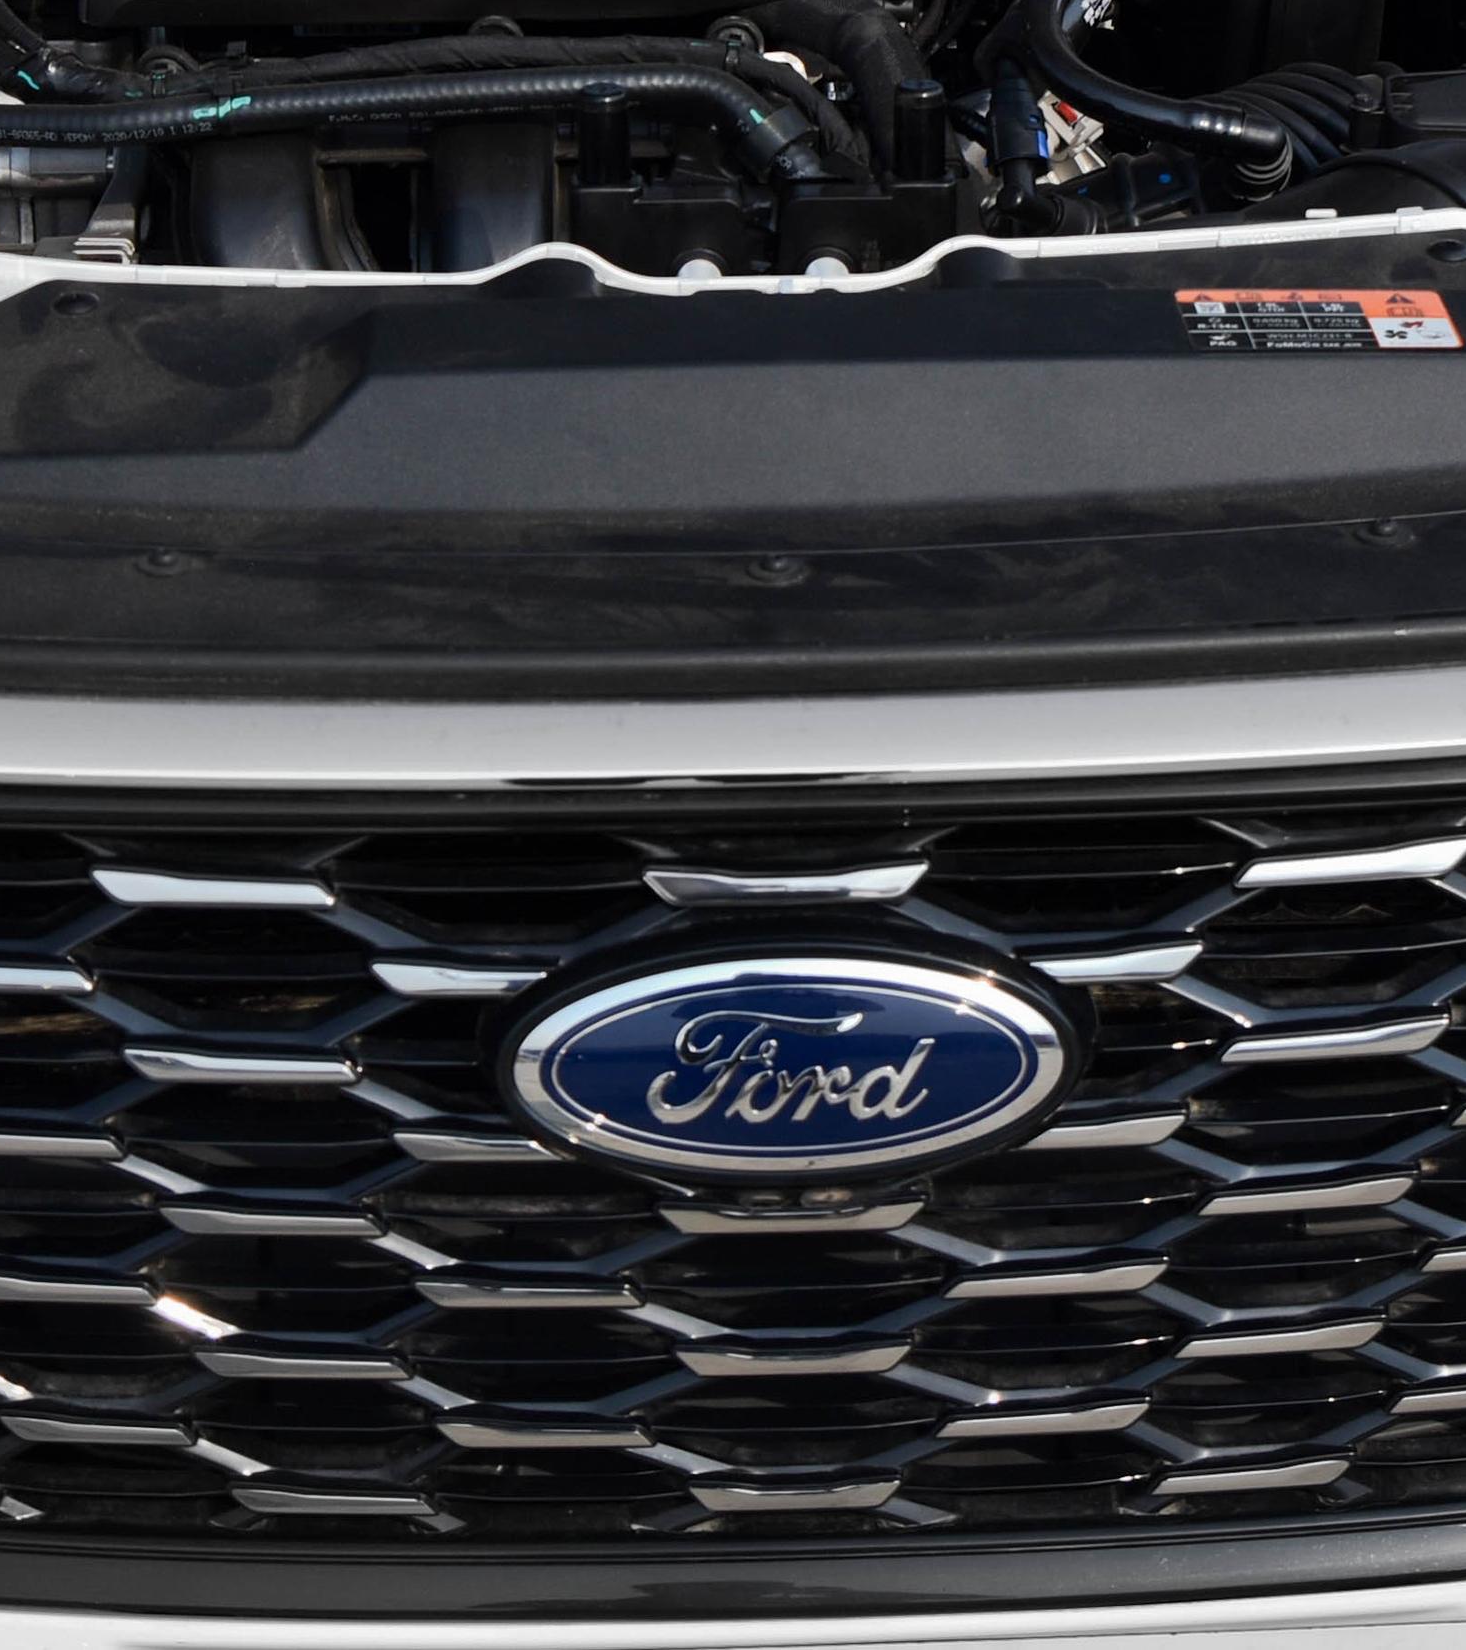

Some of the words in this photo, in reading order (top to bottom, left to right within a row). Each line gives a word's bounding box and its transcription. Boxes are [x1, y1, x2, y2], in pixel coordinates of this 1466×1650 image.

[101, 128, 165, 143] 2020/12/10
[181, 122, 213, 134] 12:22
[646, 1010, 935, 1124] Ford
